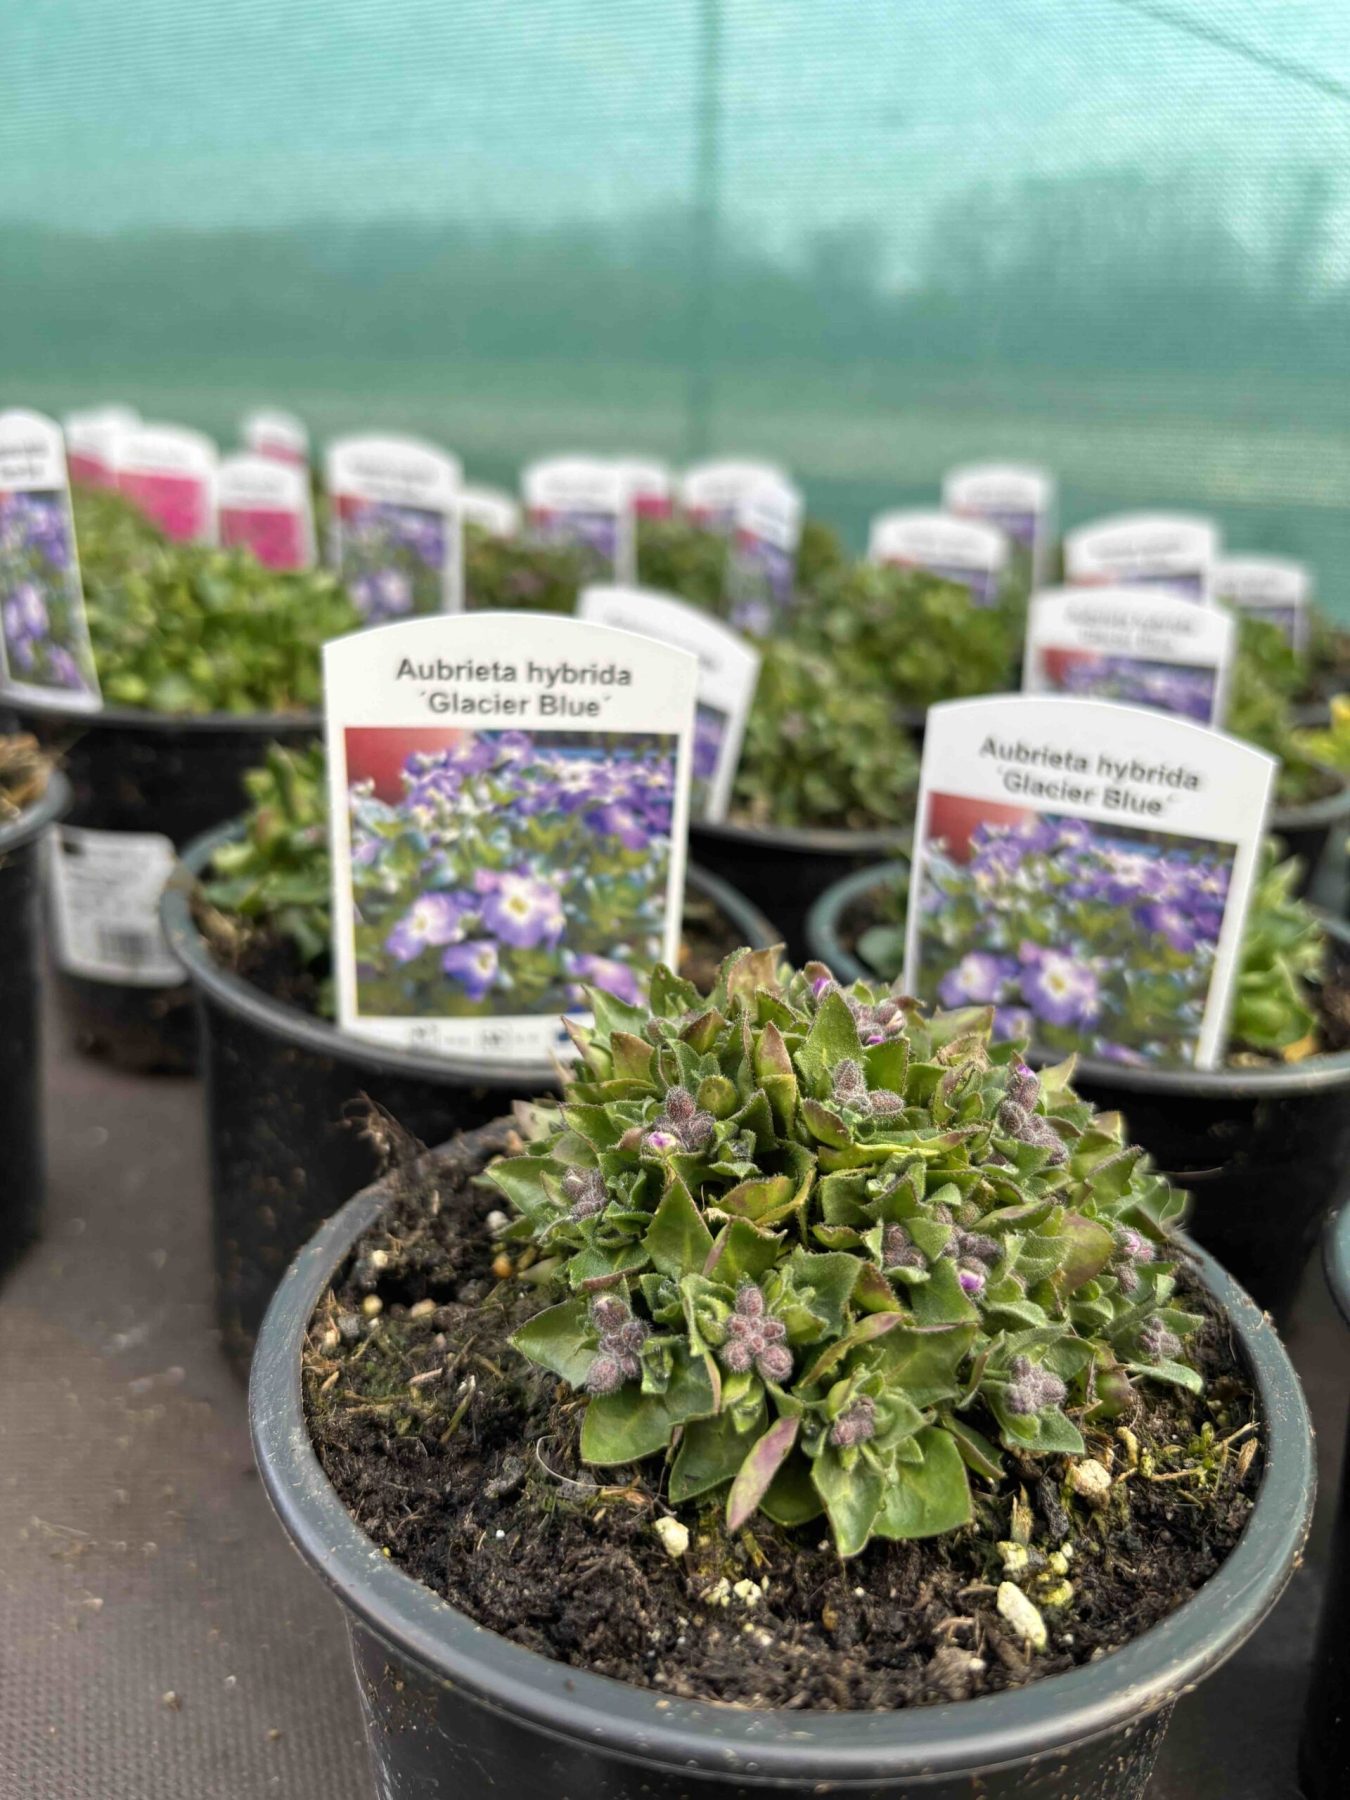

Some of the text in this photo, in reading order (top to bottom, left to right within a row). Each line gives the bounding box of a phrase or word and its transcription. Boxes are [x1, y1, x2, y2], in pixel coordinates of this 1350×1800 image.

[396, 658, 632, 689] Aubrieta hybrida
[979, 737, 1200, 790] Aubrieta hybrida
